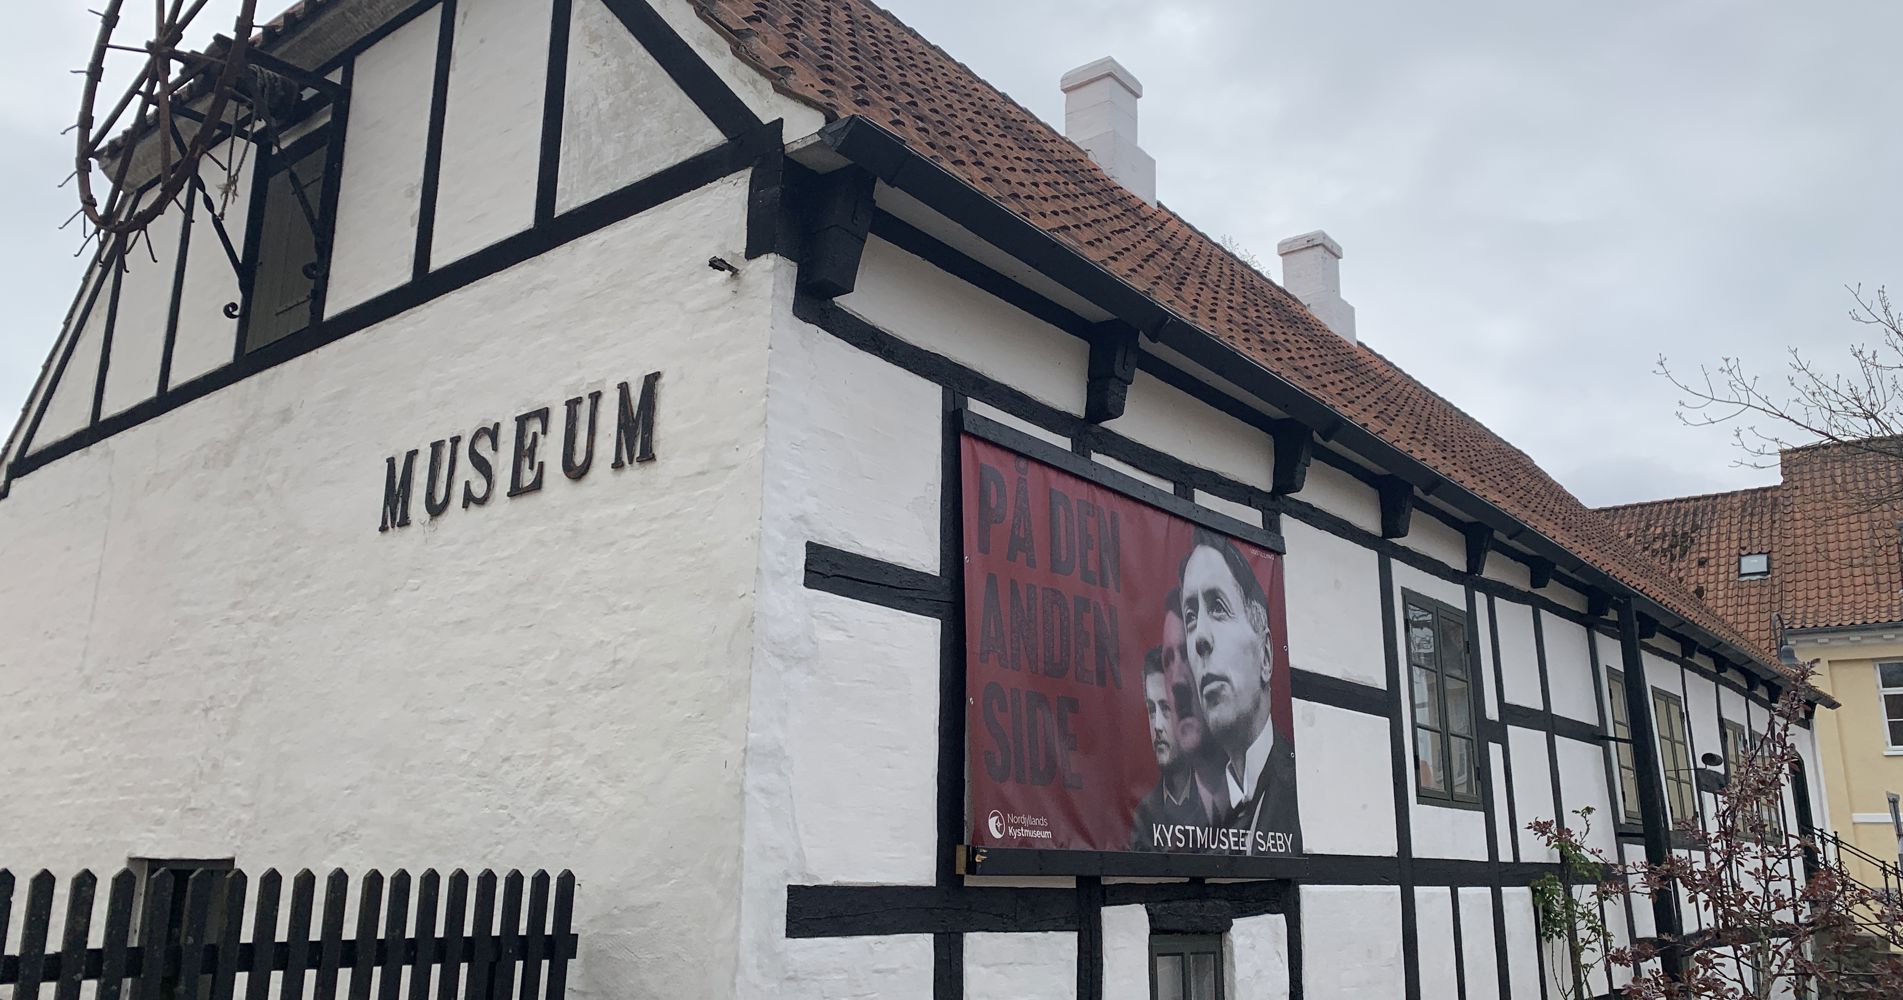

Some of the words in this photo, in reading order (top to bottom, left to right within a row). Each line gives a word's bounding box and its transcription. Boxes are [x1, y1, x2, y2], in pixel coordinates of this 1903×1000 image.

[379, 371, 661, 532] MUSEUM
[978, 456, 1036, 569] PÅ
[1049, 487, 1121, 593] DEN
[979, 572, 1122, 690] ANDEN
[982, 681, 1084, 790] SIDE
[1007, 813, 1049, 827] Nordjyllands
[1008, 826, 1052, 839] Kystmuseum
[1255, 831, 1293, 853] SÆBY
